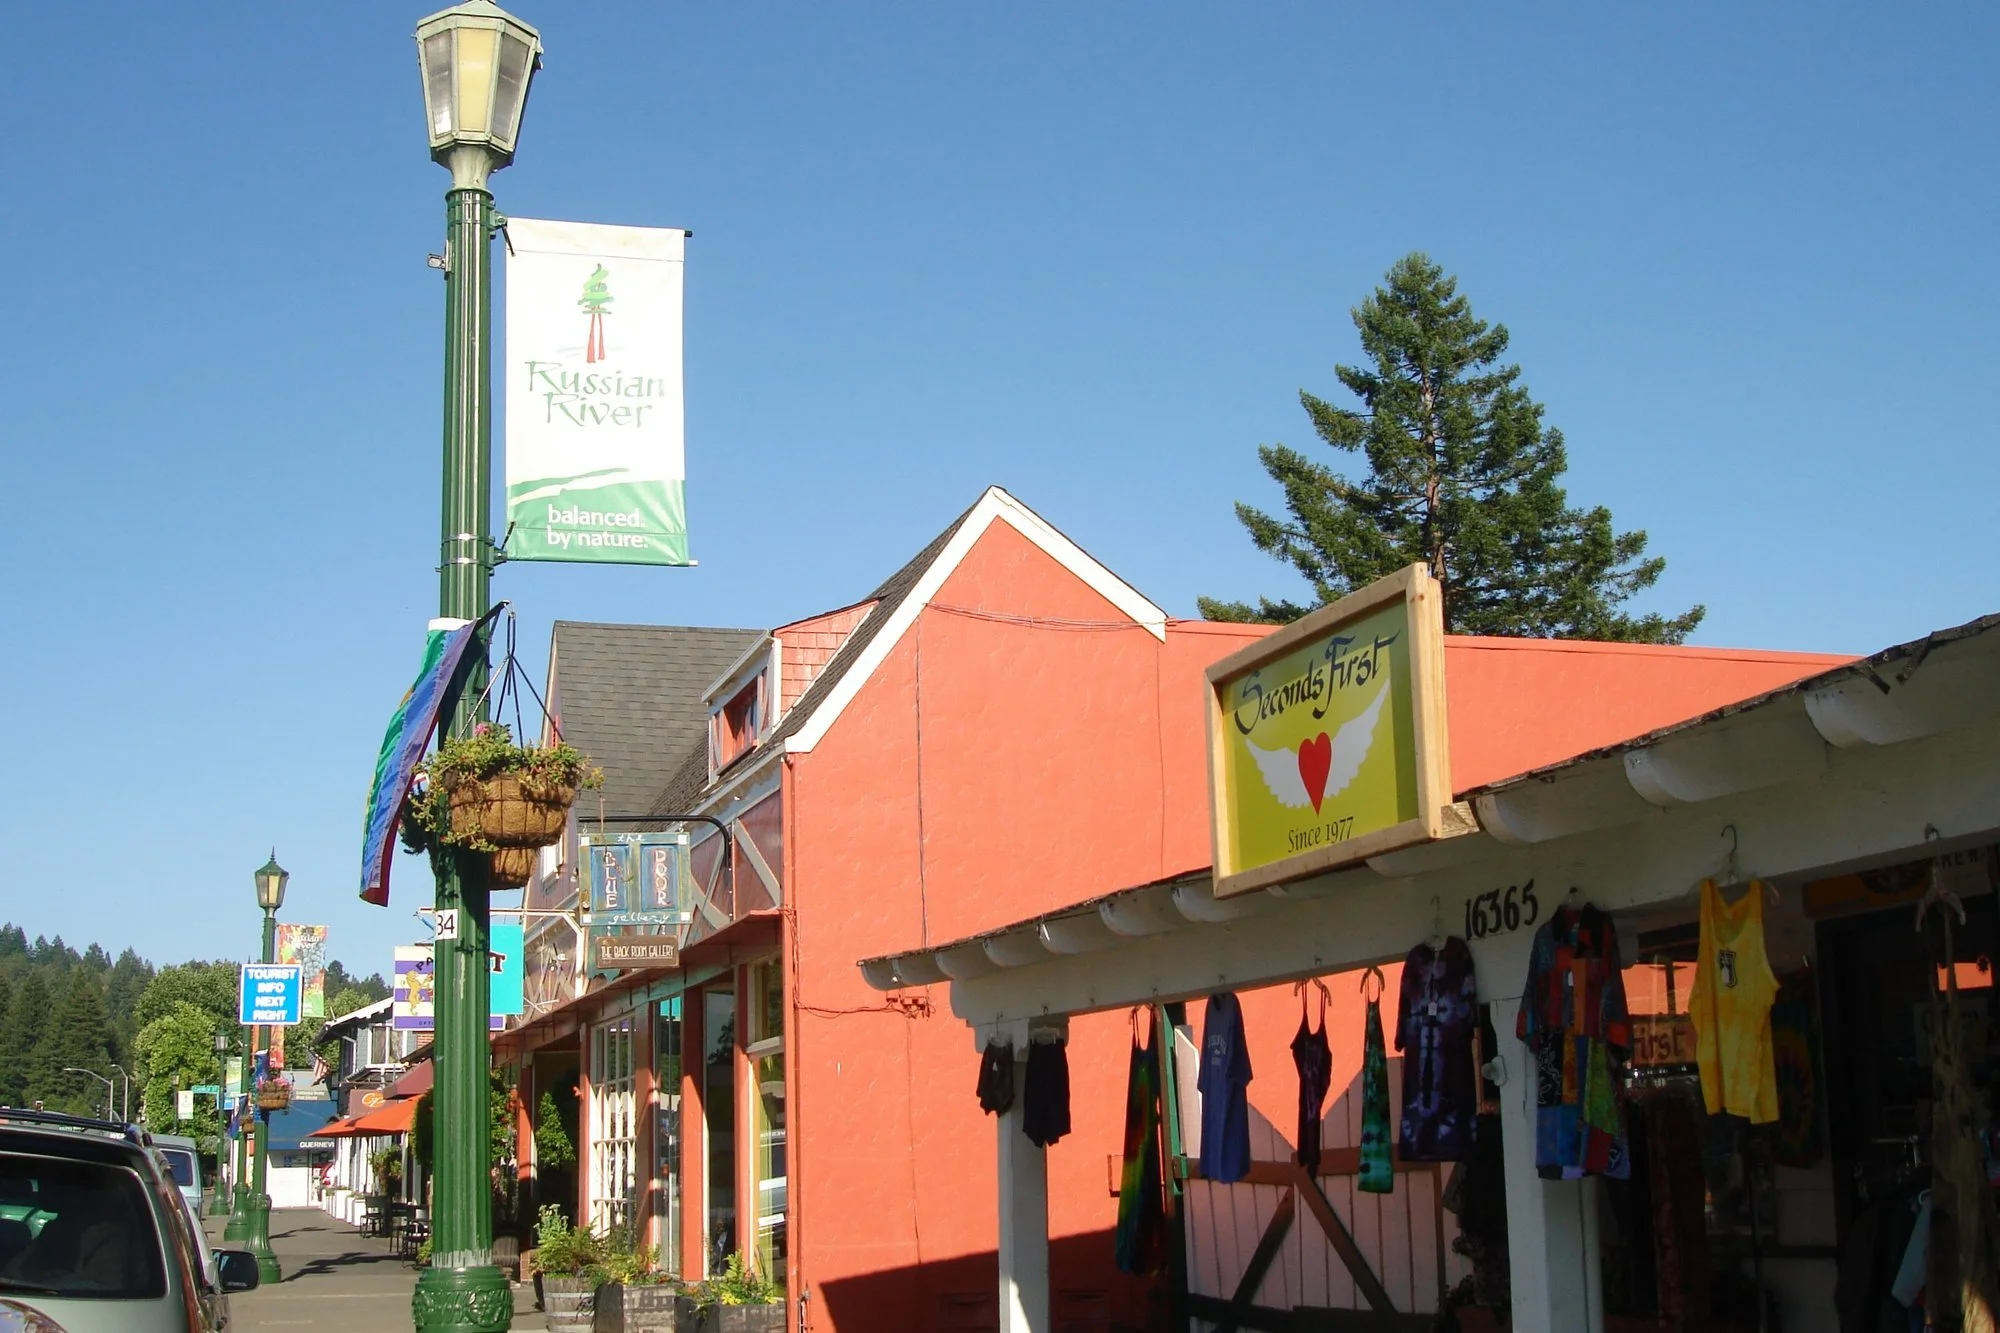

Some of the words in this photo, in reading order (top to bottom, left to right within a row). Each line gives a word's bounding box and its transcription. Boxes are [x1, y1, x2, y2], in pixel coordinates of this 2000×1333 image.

[524, 360, 665, 398] Russian
[543, 391, 653, 428] River
[548, 503, 646, 528] balanced.
[547, 524, 571, 550] by
[578, 531, 648, 549] nature.
[1234, 658, 1325, 735] Seconds
[1312, 628, 1401, 720] First
[1288, 826, 1321, 853] Since
[1326, 816, 1354, 844] 1977
[604, 851, 618, 908] BLUE
[655, 850, 670, 905] DOOR
[1465, 878, 1538, 941] 16365
[601, 945, 612, 958] THE
[631, 945, 647, 958] ROOM
[648, 944, 675, 957] GALLERY
[247, 968, 297, 980] TOURIST
[257, 981, 286, 993] INFO
[252, 1009, 288, 1021] RIGHT
[255, 996, 287, 1007] NEXT
[1634, 1026, 1687, 1060] irst
